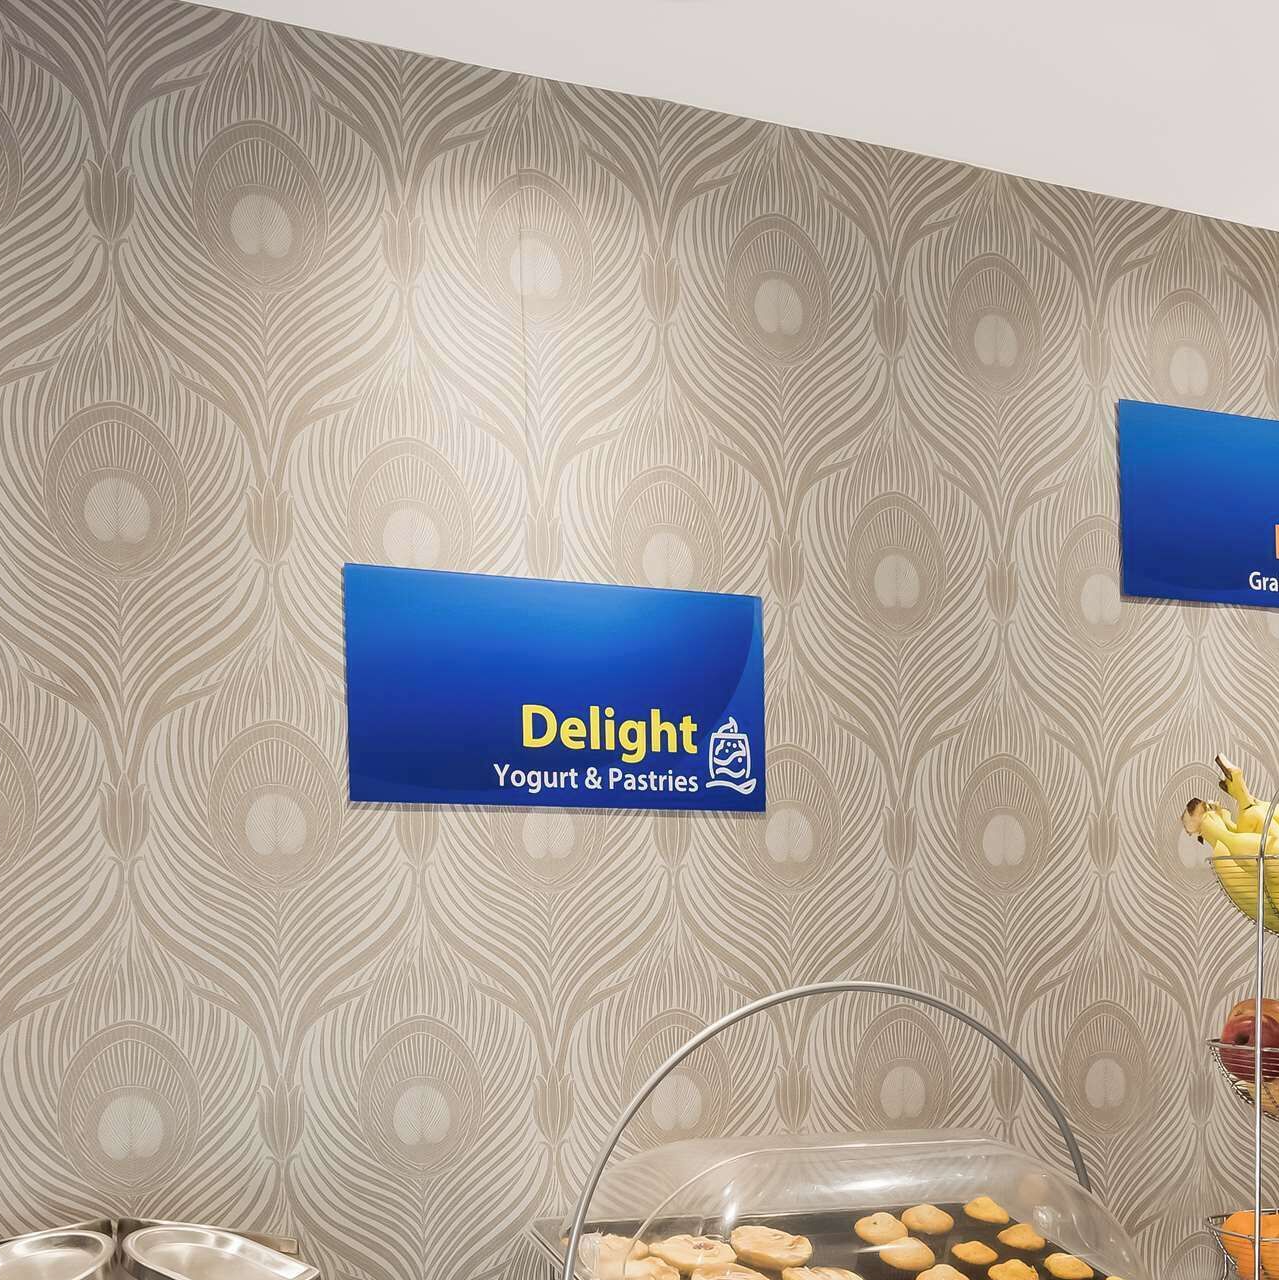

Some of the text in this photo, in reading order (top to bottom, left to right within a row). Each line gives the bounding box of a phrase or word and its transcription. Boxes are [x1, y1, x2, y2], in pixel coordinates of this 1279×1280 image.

[522, 704, 698, 764] Delight
[493, 763, 699, 794] Yogurt & Pastries
